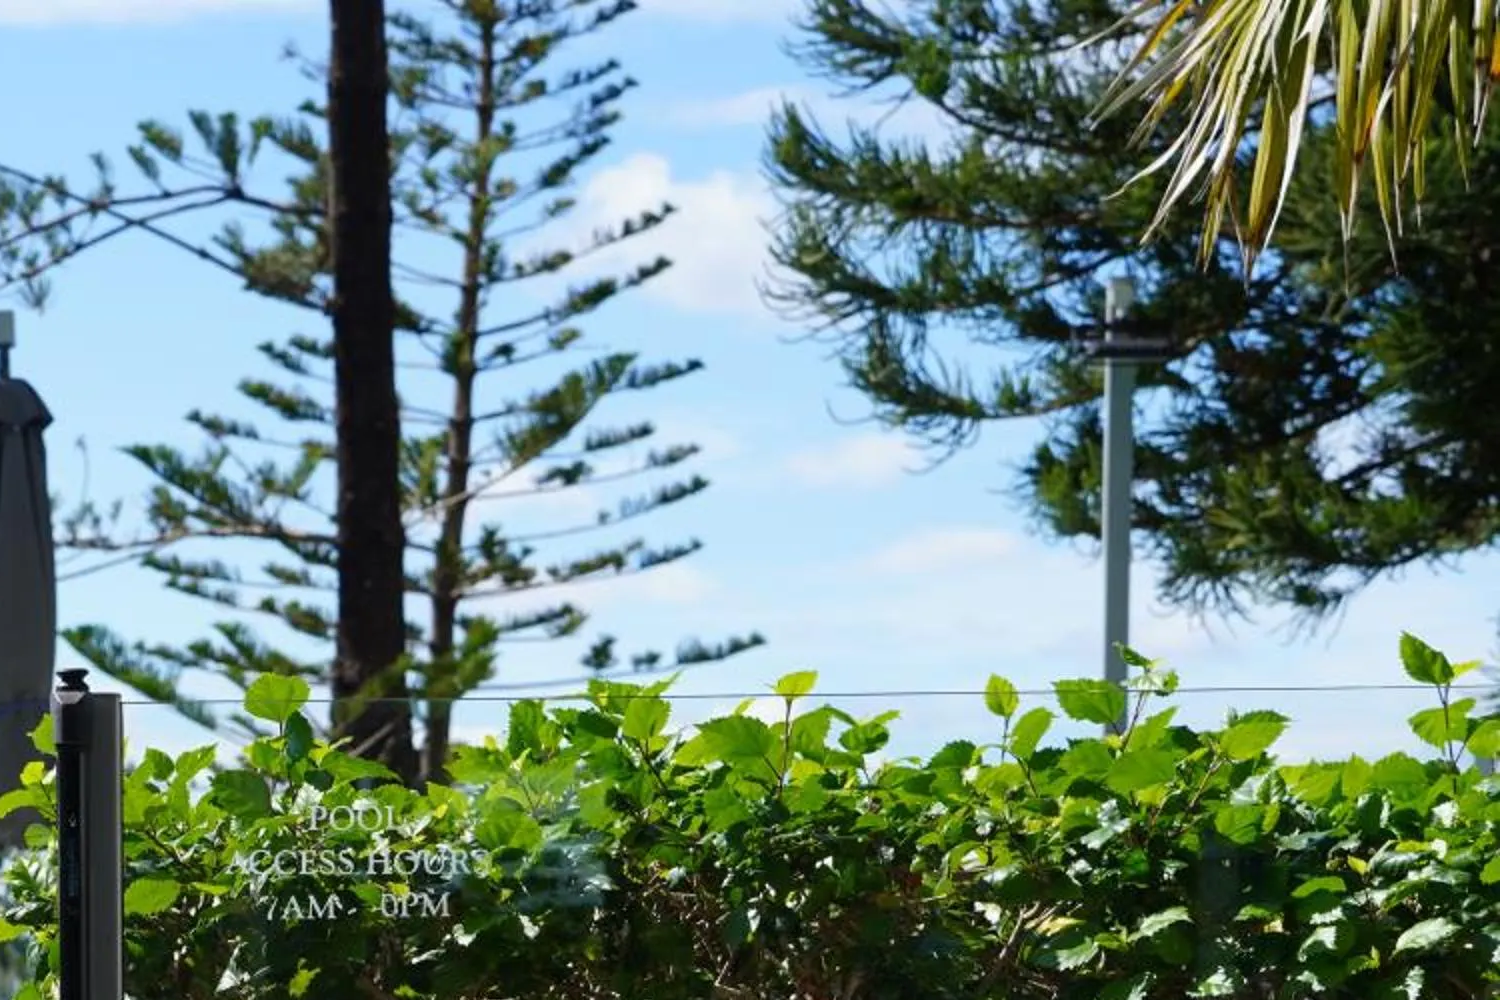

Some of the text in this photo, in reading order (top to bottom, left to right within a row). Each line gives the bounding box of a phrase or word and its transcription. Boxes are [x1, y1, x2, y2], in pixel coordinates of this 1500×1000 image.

[308, 804, 402, 831] POOL
[225, 849, 491, 877] ACCESS HOURS
[257, 893, 338, 920] 7AM
